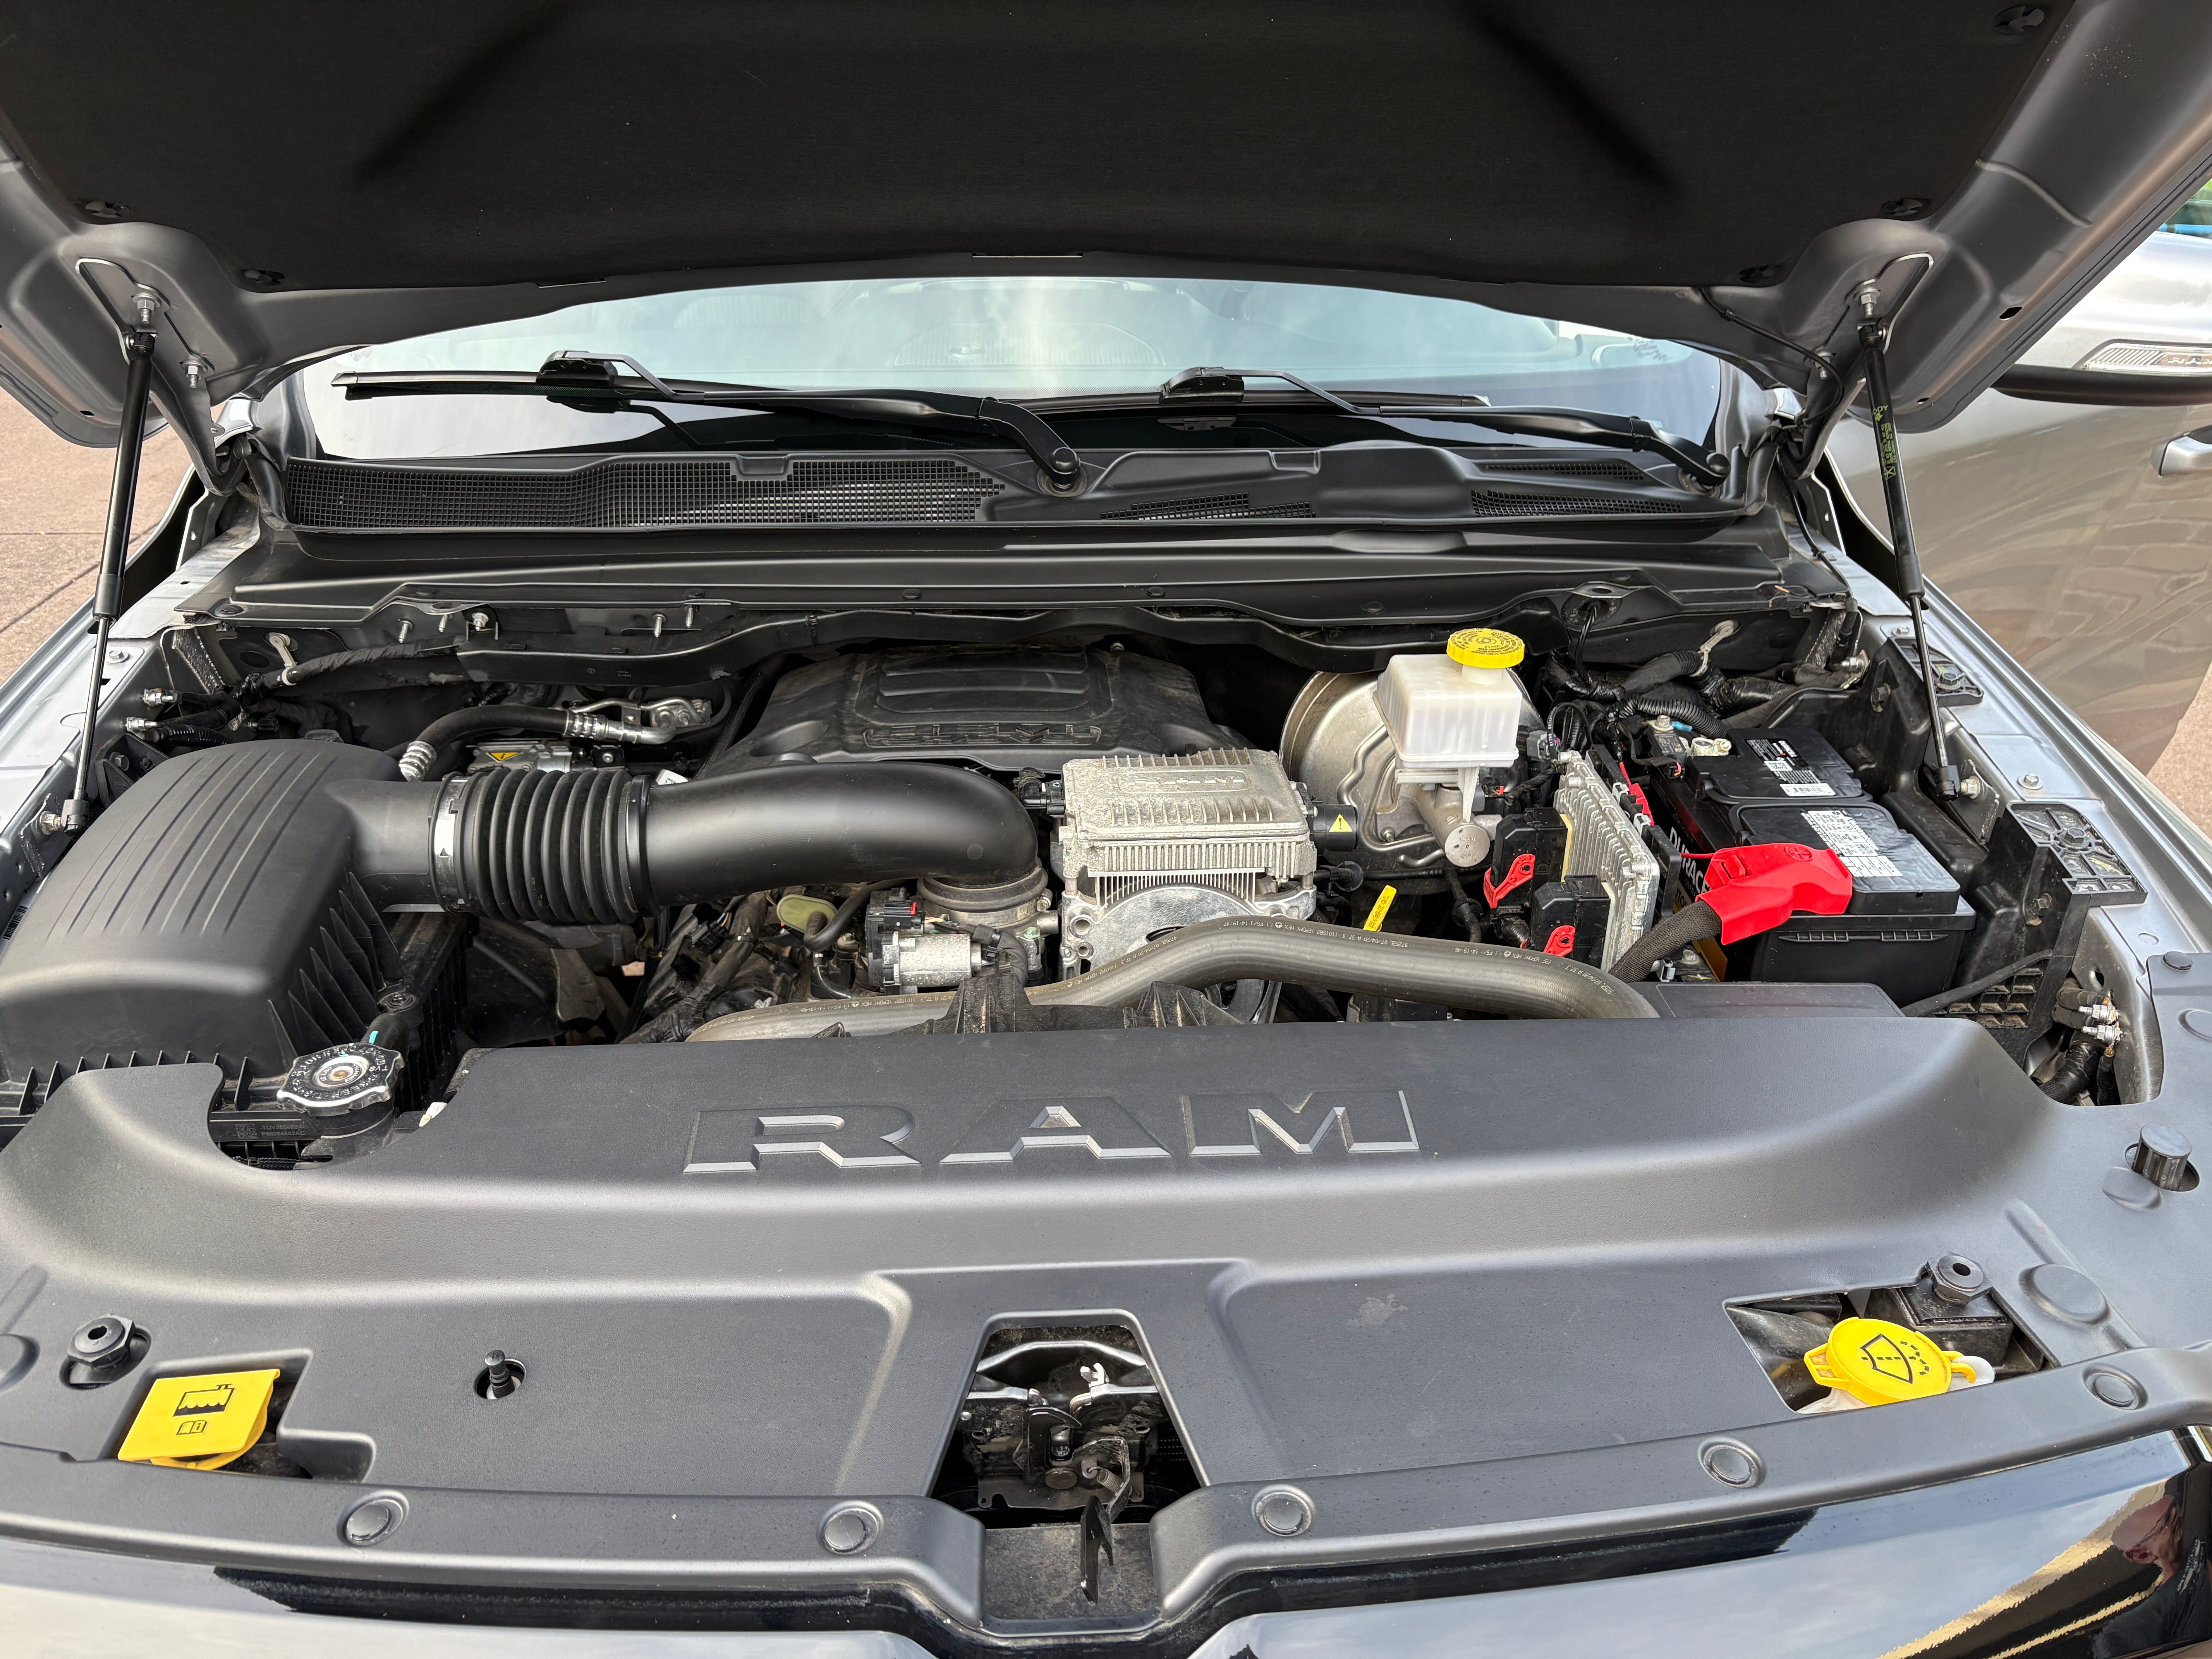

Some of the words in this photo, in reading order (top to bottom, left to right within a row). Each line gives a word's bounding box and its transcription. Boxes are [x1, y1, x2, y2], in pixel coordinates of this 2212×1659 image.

[1872, 405, 1889, 416] ODY
[1669, 826, 1712, 894] DURACE
[682, 1089, 1420, 1174] RAM
